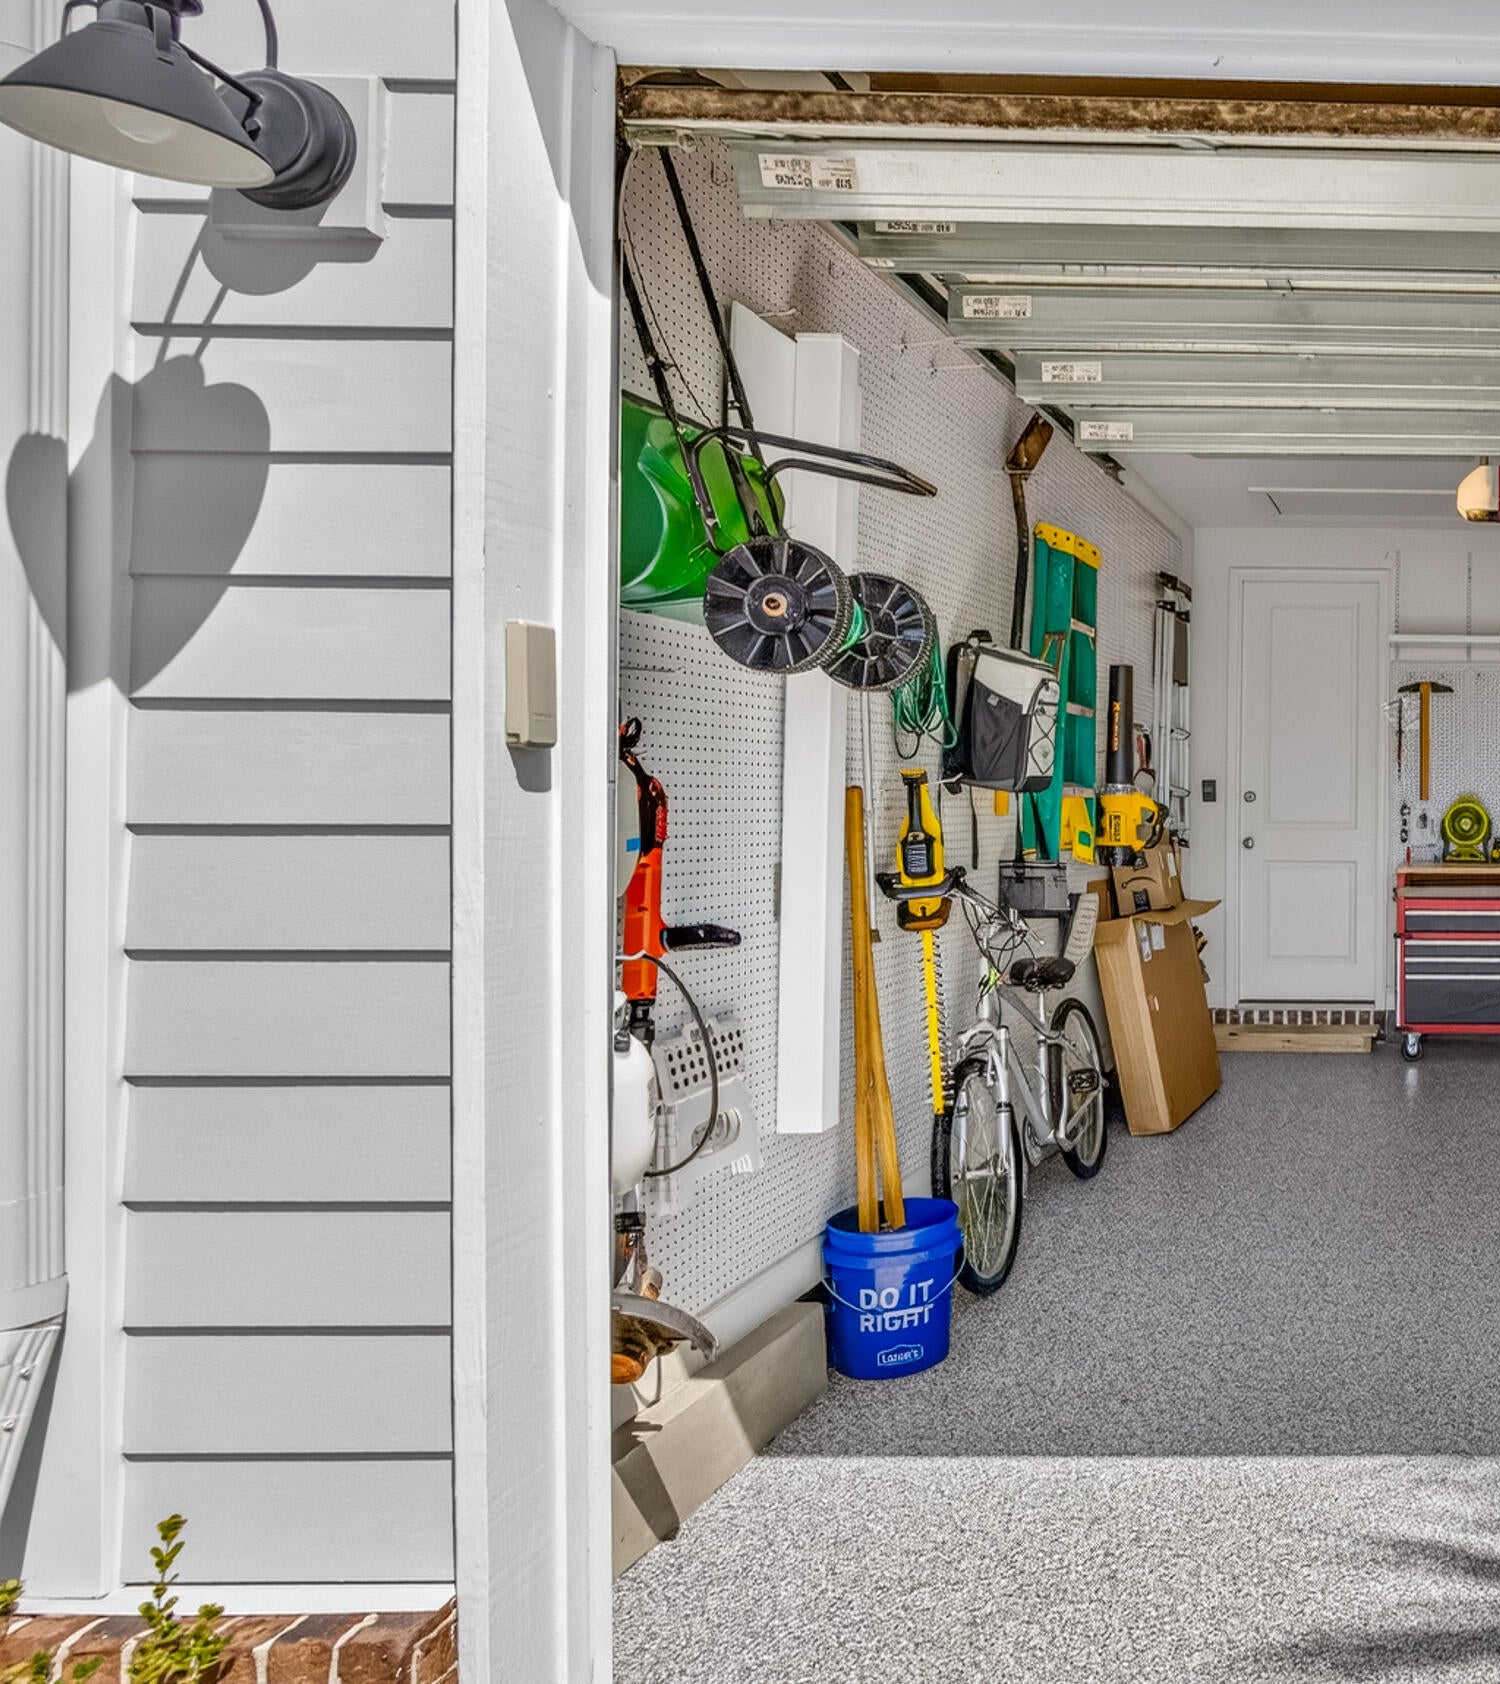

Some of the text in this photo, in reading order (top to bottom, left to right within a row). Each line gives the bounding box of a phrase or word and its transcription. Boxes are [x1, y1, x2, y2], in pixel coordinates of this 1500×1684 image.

[860, 1278, 934, 1310] DO IT
[860, 1303, 934, 1333] RIGHT
